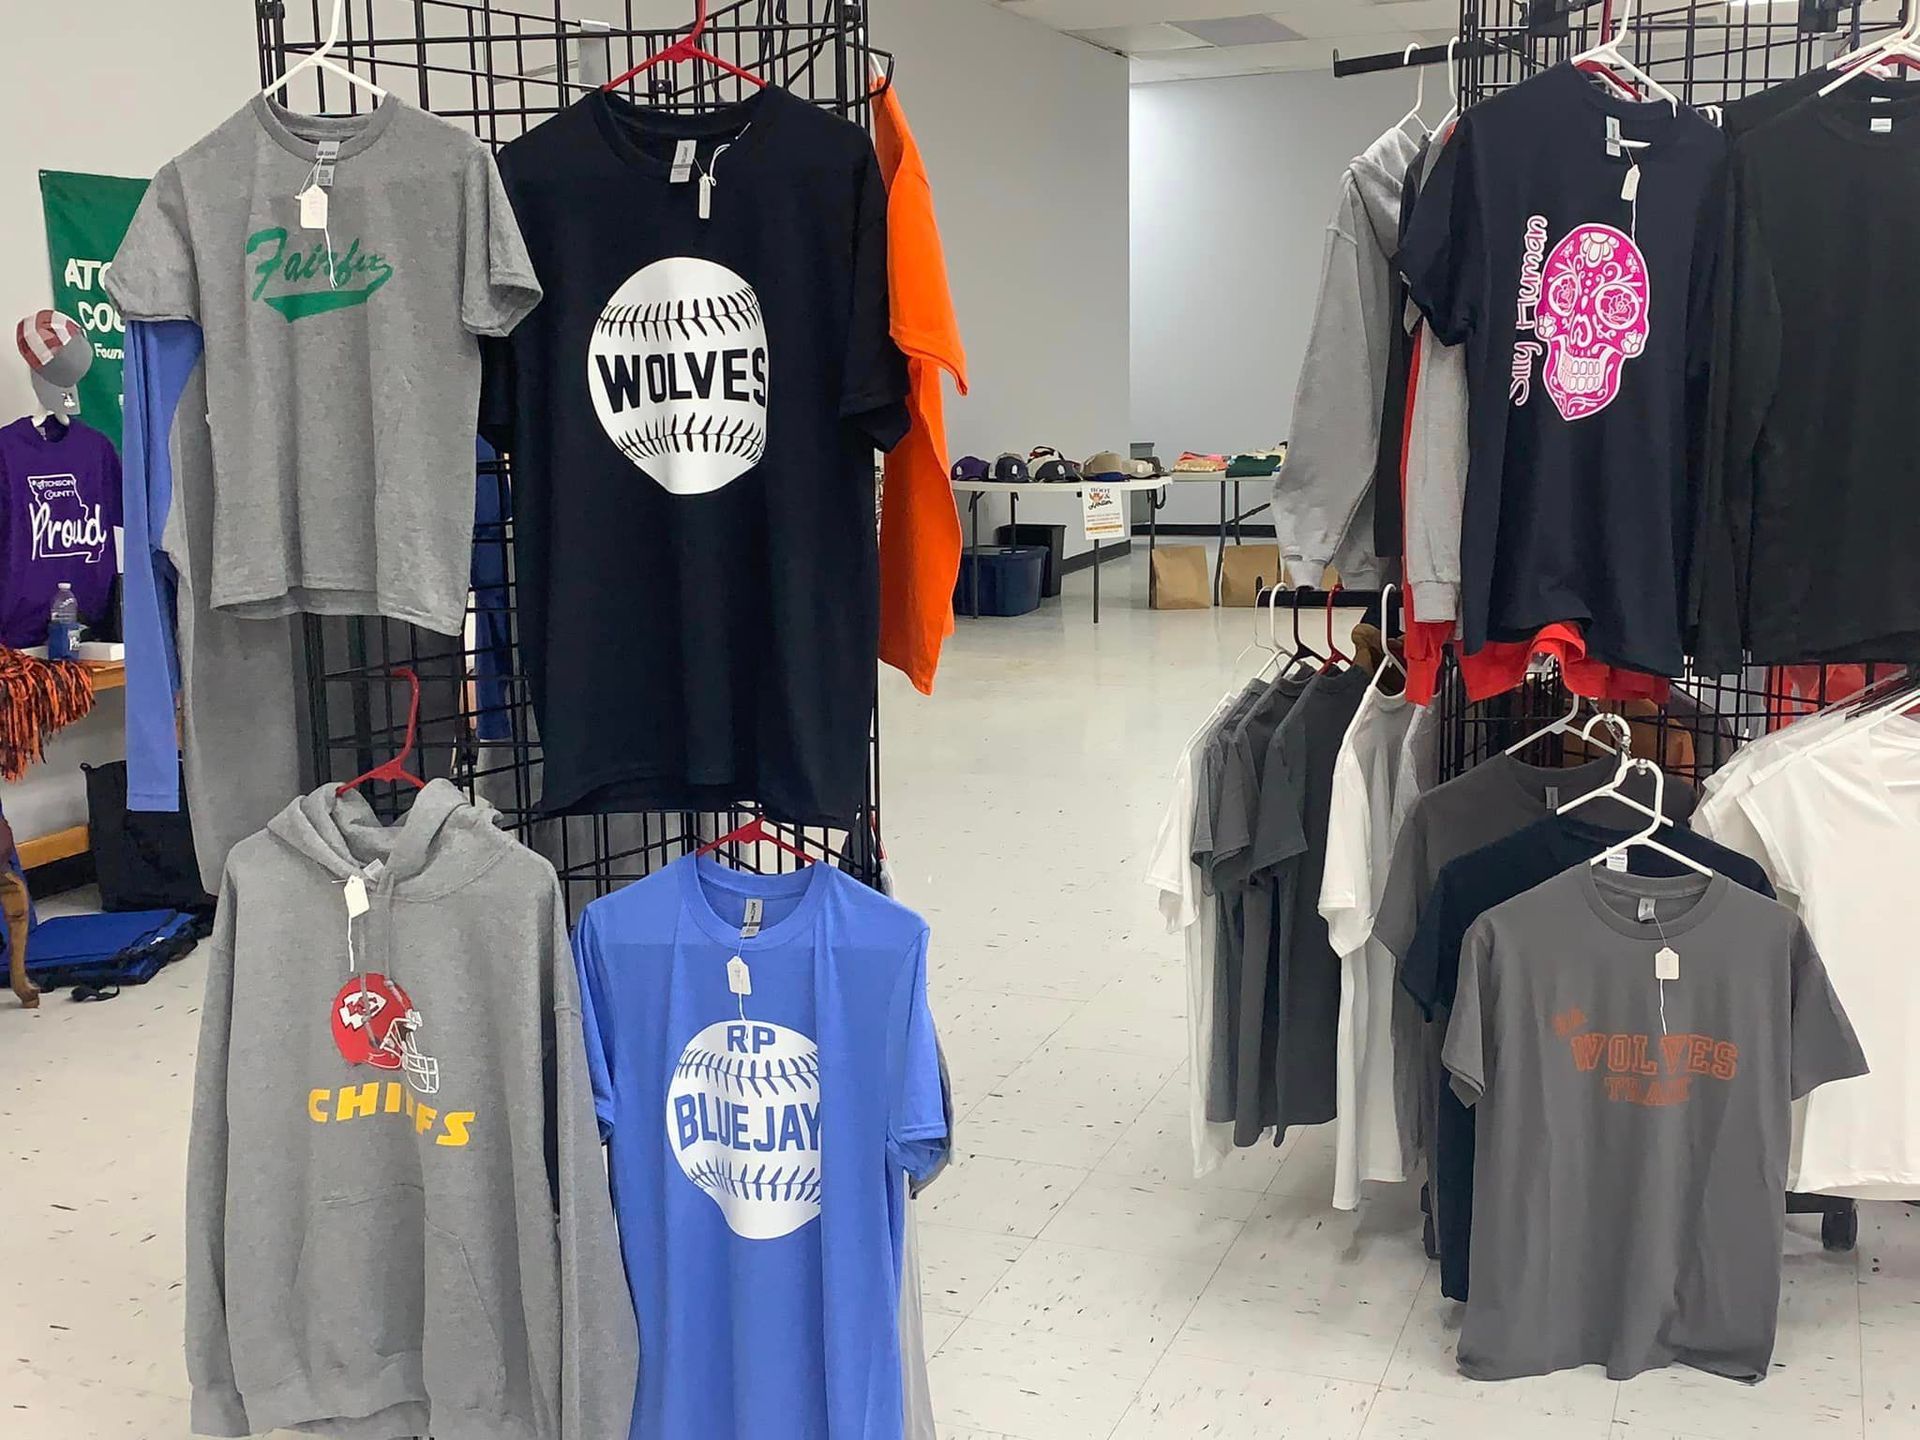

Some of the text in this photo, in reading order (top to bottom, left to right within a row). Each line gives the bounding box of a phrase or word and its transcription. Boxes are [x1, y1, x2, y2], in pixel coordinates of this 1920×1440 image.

[1509, 215, 1548, 406] Silly Human
[94, 343, 124, 360] Foun
[596, 347, 766, 414] WOLVES
[29, 502, 107, 561] Proud
[727, 1025, 775, 1054] RP
[1571, 1033, 1738, 1081] WOLVES
